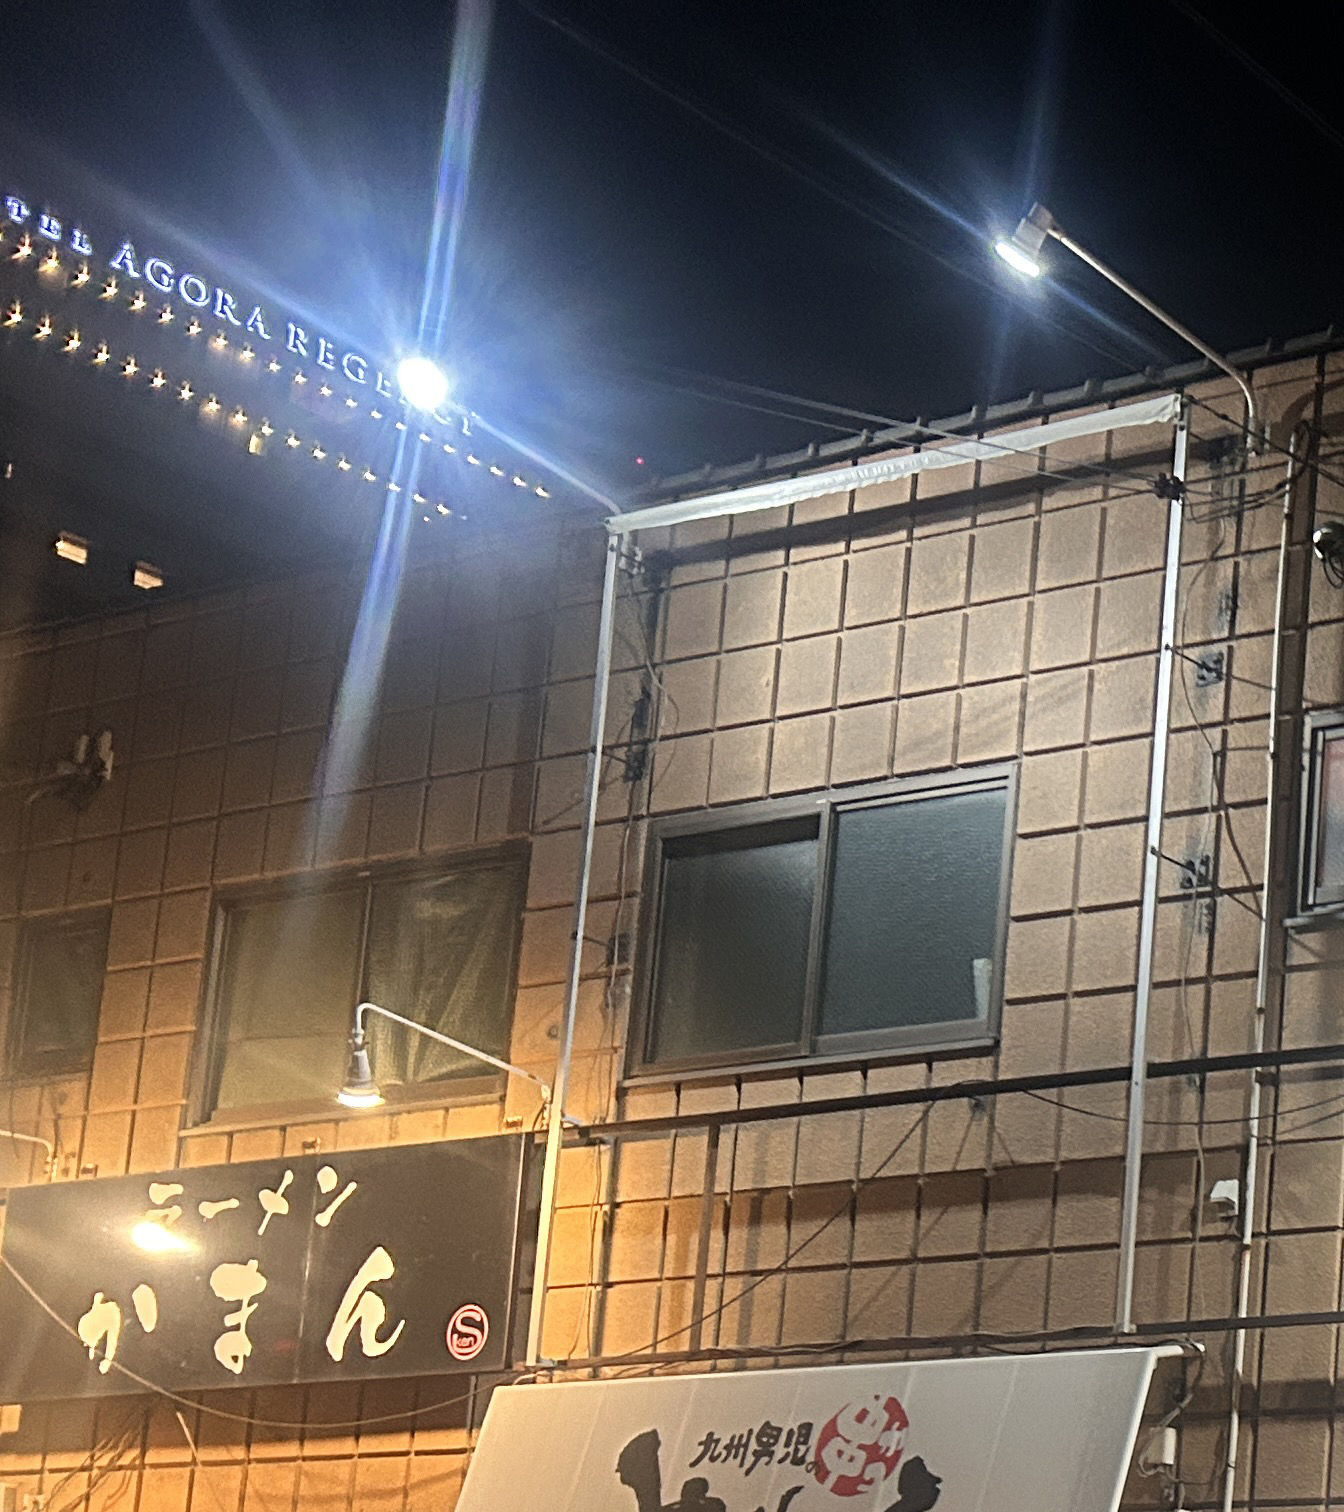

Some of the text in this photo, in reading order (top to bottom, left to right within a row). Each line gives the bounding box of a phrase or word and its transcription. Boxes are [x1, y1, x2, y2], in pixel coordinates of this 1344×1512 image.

[110, 241, 271, 341] AGORA
[144, 1165, 359, 1236] ラーメン
[77, 1246, 406, 1374] かまん
